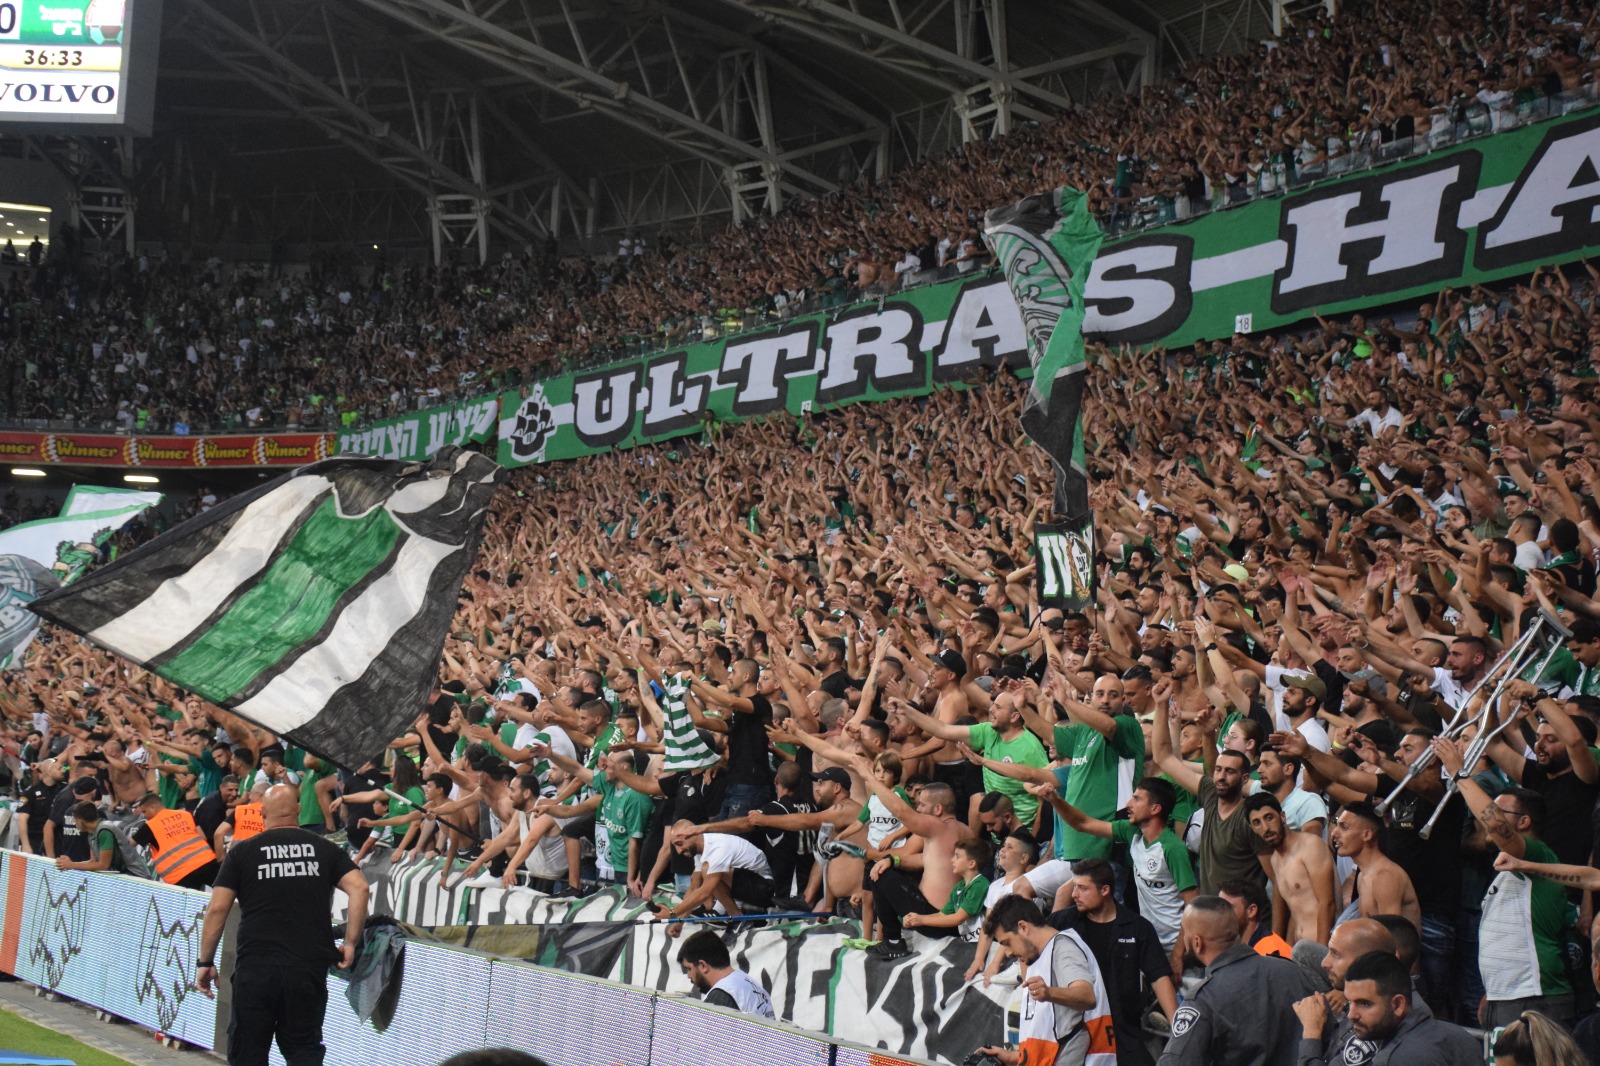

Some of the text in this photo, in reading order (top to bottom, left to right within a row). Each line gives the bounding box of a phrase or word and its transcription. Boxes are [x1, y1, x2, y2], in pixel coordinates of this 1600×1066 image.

[24, 49, 83, 66] 36:33
[1239, 317, 1250, 331] 18
[572, 234, 1194, 447] ULTRAS
[56, 438, 119, 458] Winner
[138, 440, 190, 460] Winner
[204, 440, 250, 460] Winner
[264, 440, 311, 458] Winner
[240, 825, 264, 833] בטחה
[243, 820, 264, 828] טאור
[261, 843, 315, 860] מטאור
[257, 860, 320, 880] אבטחה
